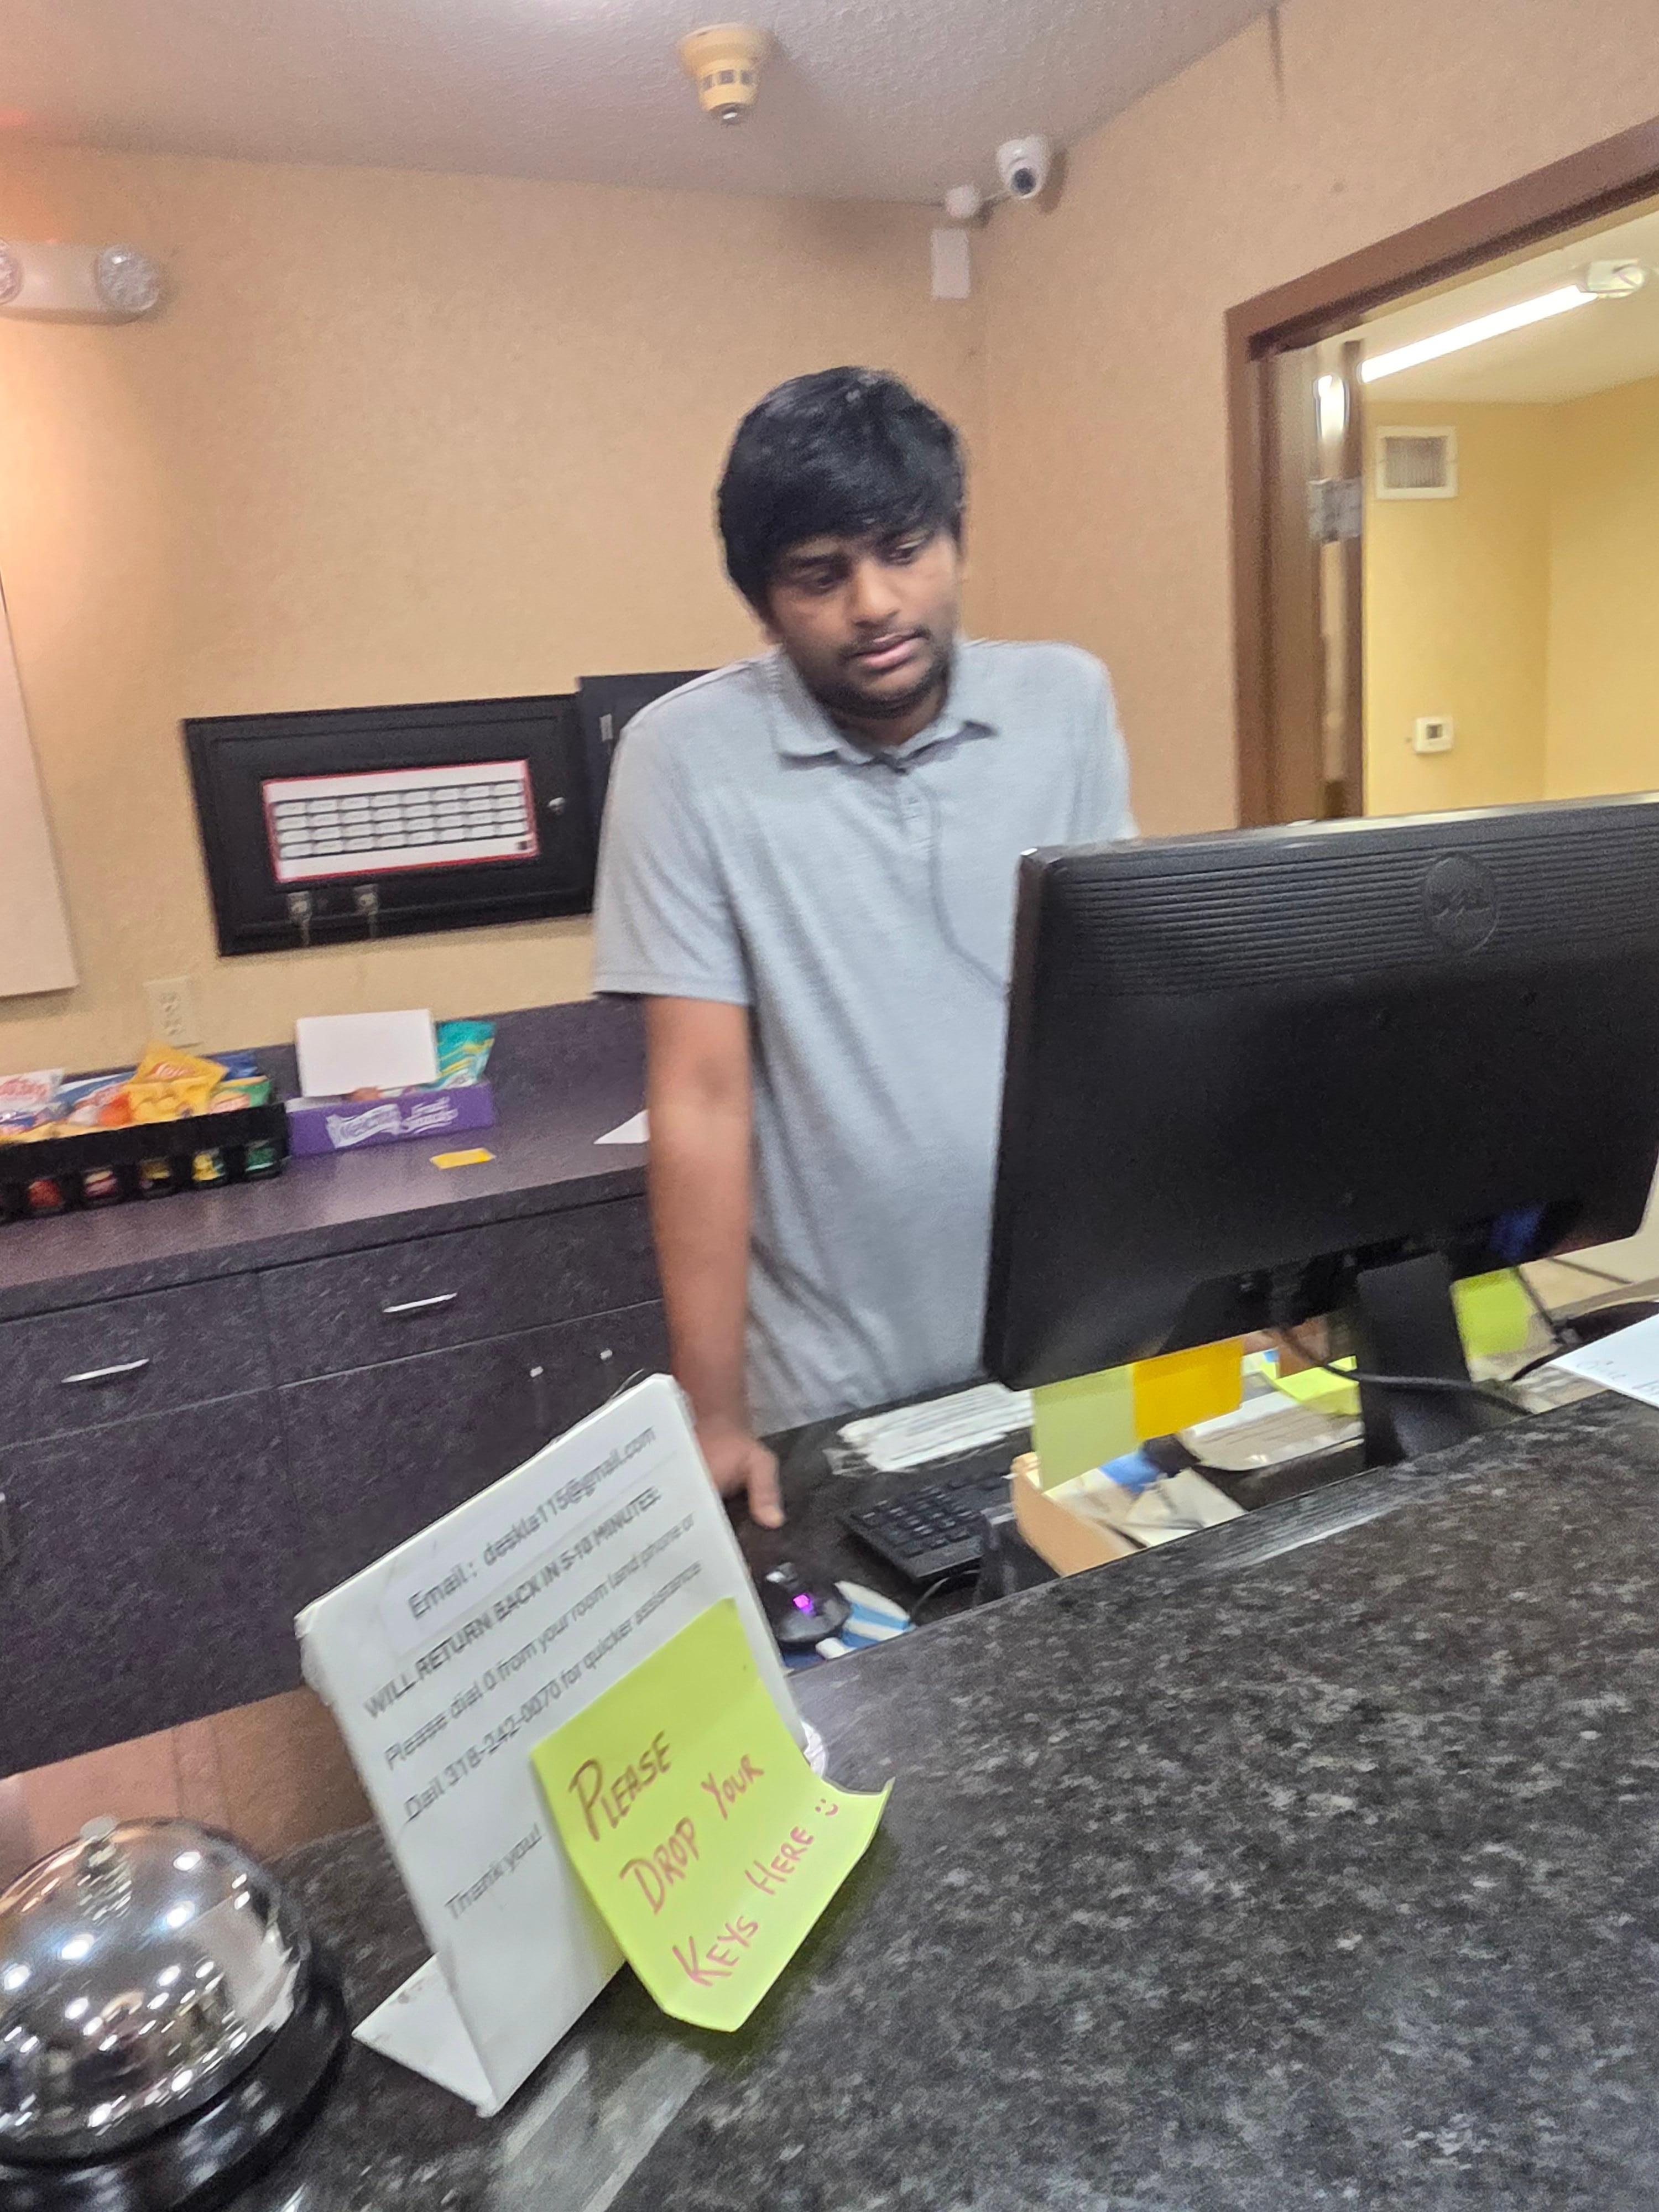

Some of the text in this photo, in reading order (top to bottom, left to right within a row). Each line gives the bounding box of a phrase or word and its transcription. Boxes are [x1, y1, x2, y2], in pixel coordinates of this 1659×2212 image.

[363, 1672, 417, 1719] WILL
[415, 1611, 492, 1680] RETURN
[493, 1576, 541, 1622] BACK
[539, 1561, 560, 1588] IN
[560, 1534, 593, 1571] 5-10
[384, 1711, 448, 1771] Please
[450, 1680, 484, 1719] dial
[483, 1668, 497, 1691] 0
[496, 1639, 538, 1682] from
[537, 1611, 568, 1654] your
[571, 1580, 609, 1621] room
[640, 1524, 684, 1568] phone
[560, 1662, 582, 1689] for
[583, 1618, 633, 1670] quicker
[568, 1730, 672, 1842] PLEASE
[619, 1754, 764, 1916] DROP YOUR
[444, 1822, 542, 1919] Thank you!
[672, 1915, 759, 1987] KEYS
[744, 1825, 813, 1895] HERE
